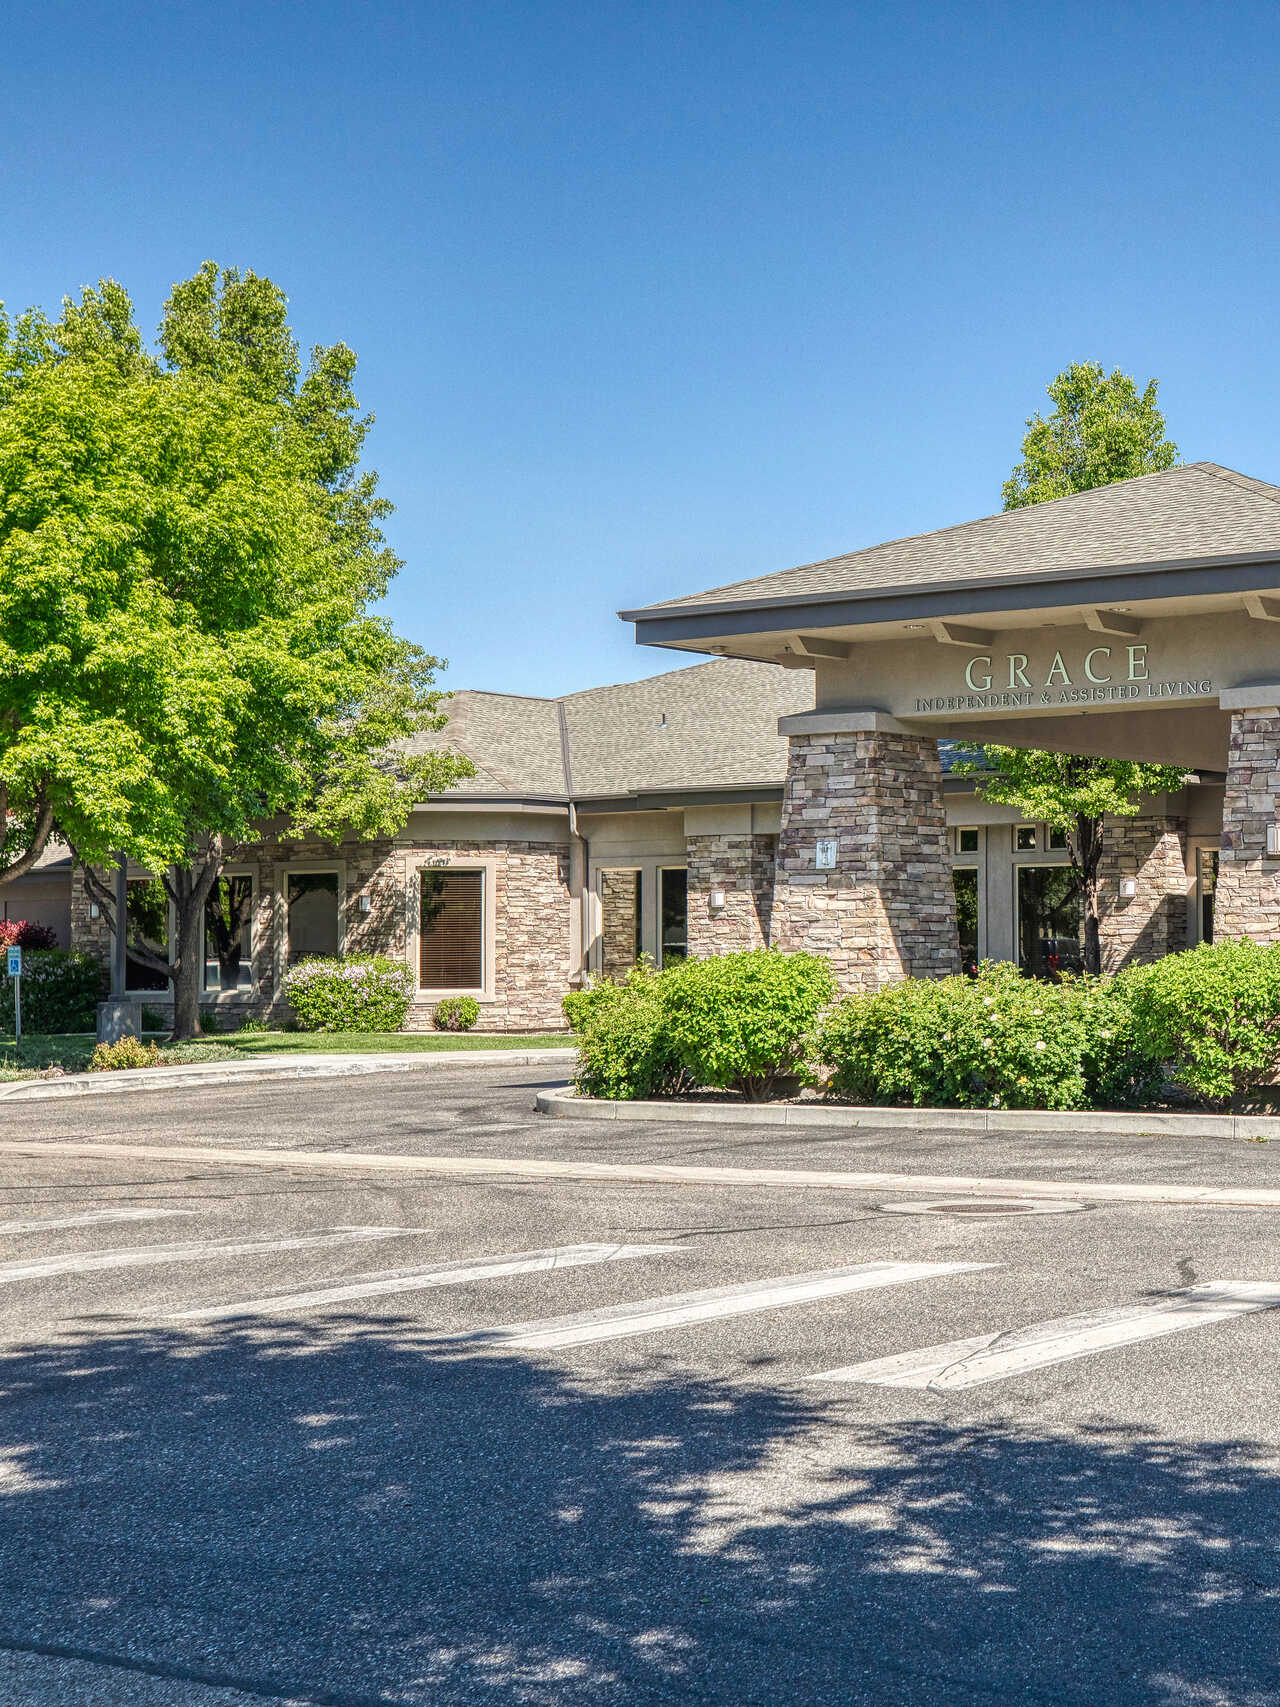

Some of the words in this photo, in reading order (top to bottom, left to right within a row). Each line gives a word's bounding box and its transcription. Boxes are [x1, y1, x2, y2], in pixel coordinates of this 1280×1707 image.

[965, 645, 1150, 692] GRACE
[915, 692, 1033, 712] INDEPENDENT
[1040, 690, 1051, 704] &
[1058, 685, 1140, 703] ASSISTED
[1147, 680, 1212, 697] LIVING
